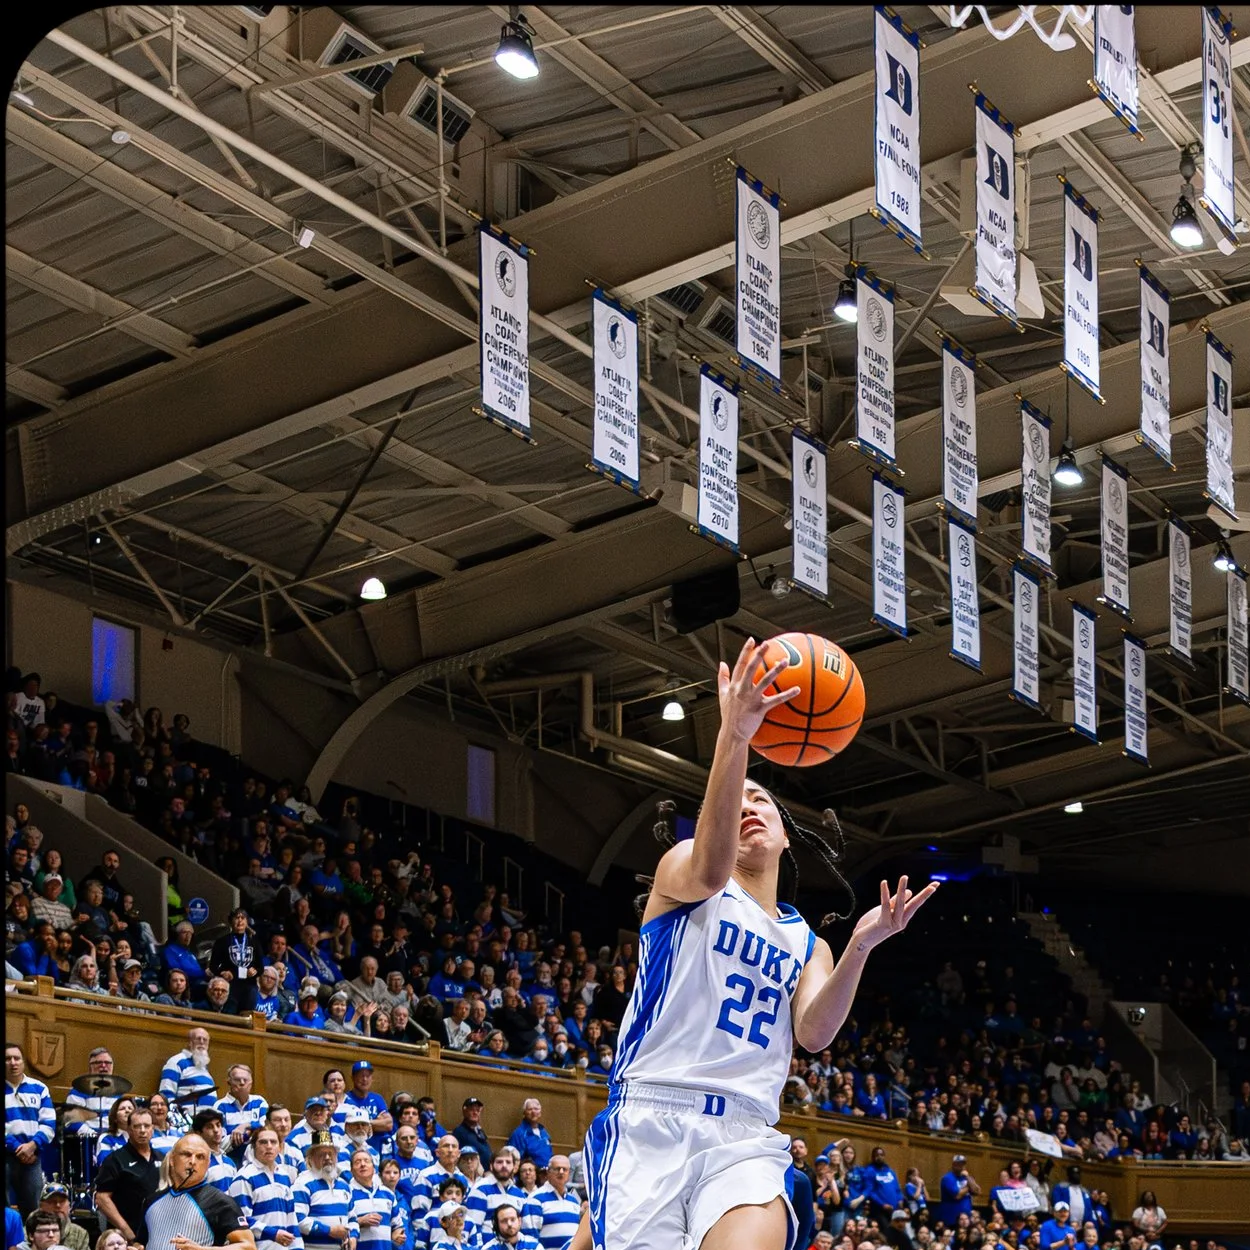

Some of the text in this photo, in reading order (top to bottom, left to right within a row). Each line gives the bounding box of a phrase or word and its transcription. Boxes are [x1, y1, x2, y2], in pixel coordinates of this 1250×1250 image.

[890, 123, 910, 151] NCAA
[879, 140, 900, 169] FINAL
[988, 209, 1007, 233] NCAA
[713, 920, 803, 997] DUKE
[716, 973, 782, 1050] 22
